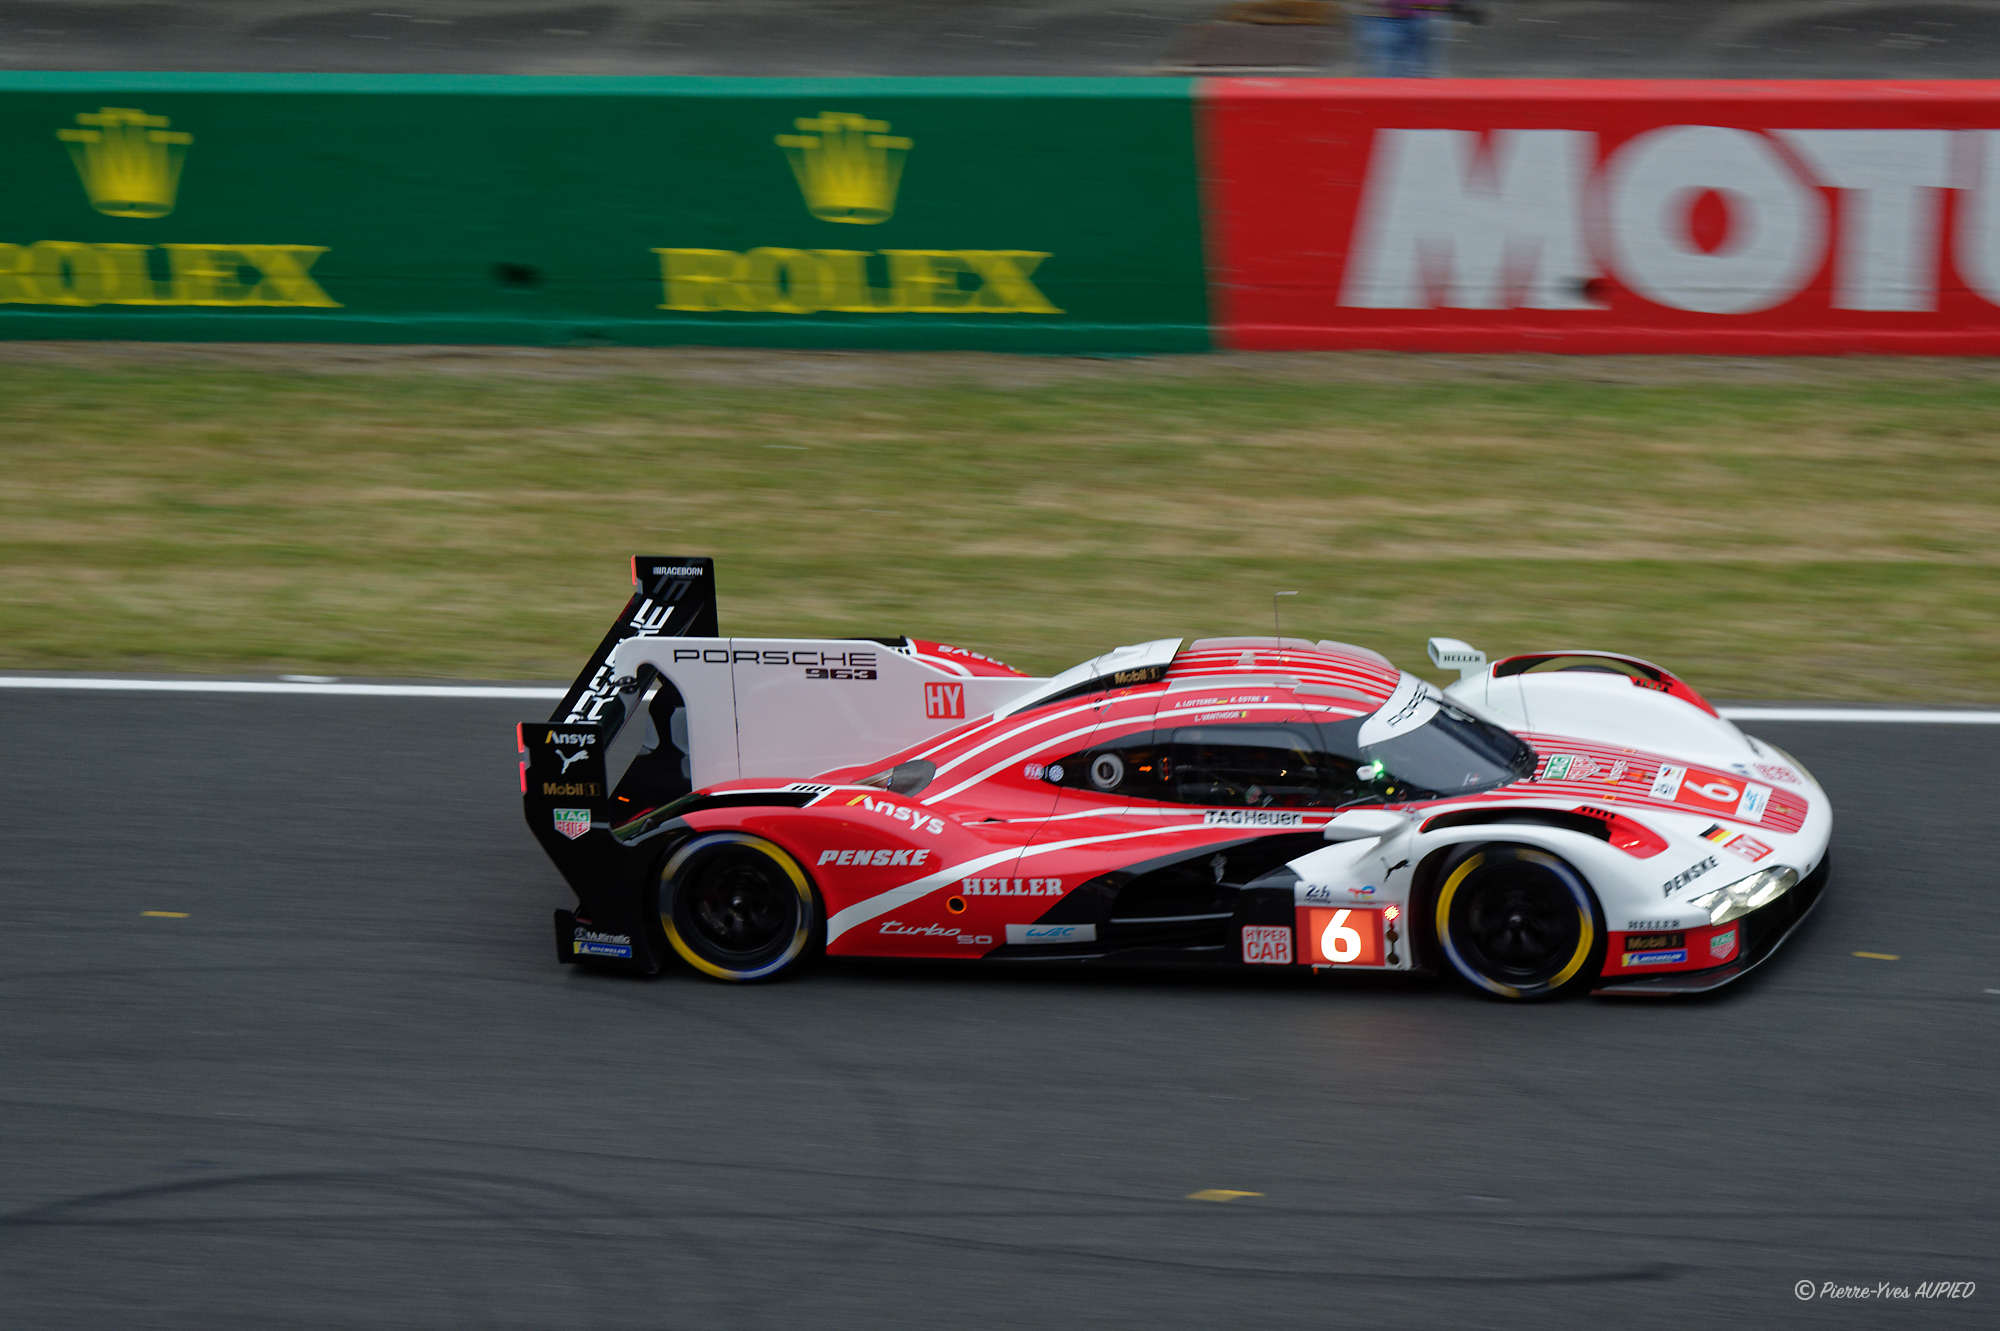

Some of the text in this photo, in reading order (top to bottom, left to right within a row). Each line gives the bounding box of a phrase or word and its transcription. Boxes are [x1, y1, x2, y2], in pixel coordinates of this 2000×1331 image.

[651, 247, 1066, 314] ROLEX
[673, 649, 877, 667] PORSCHE
[1443, 654, 1481, 663] HELLER
[805, 668, 877, 680] 963
[928, 686, 963, 715] HY
[546, 730, 596, 747] Ansys
[544, 783, 583, 795] Mobil
[1683, 780, 1739, 803] 6
[557, 811, 587, 821] TAG
[846, 794, 944, 835] Ansys
[817, 849, 930, 867] PENSKE
[1664, 855, 1719, 898] PENSKE
[962, 878, 1064, 896] HELLER
[878, 920, 961, 937] turbo
[1246, 929, 1287, 941] HYPER
[1321, 909, 1361, 962] 6
[1247, 942, 1287, 960] CAR
